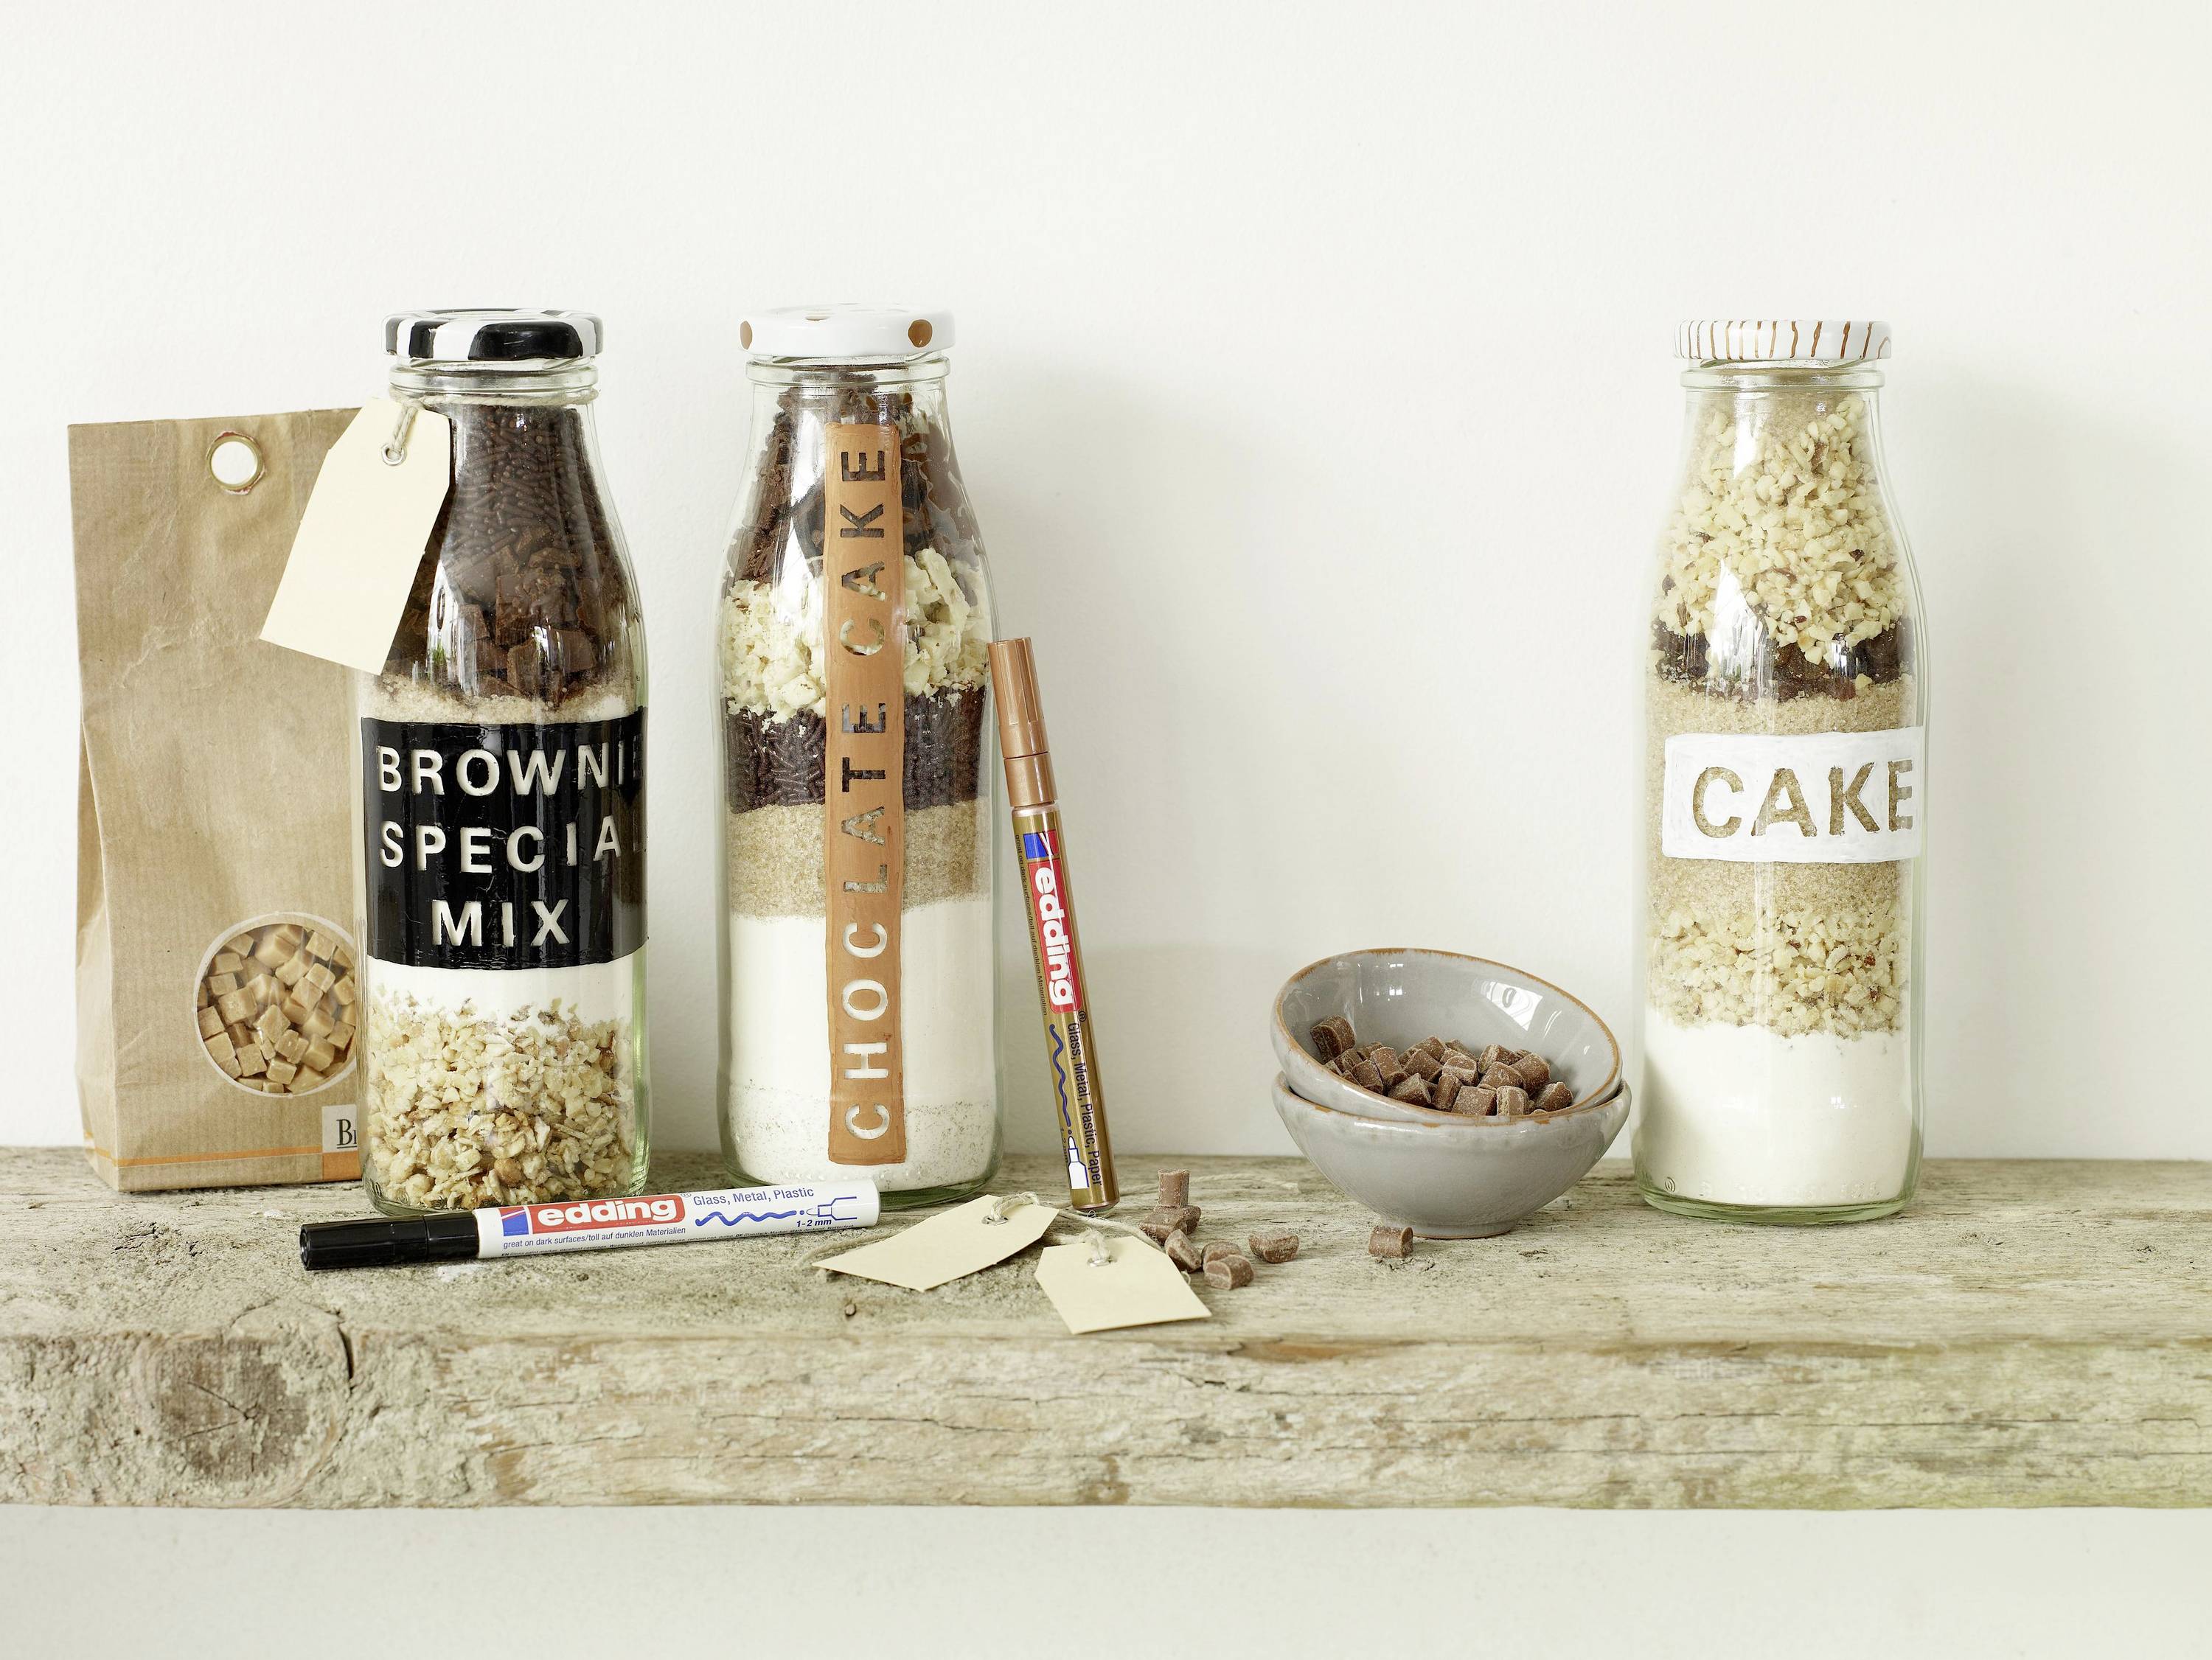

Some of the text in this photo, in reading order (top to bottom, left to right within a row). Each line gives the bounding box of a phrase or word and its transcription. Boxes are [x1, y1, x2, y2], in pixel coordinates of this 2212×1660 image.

[840, 450, 890, 1140] CHOCLATE CAKE
[1692, 759, 1913, 838] CAKE
[379, 815, 644, 873] SPECIA
[431, 899, 571, 947] MIX
[1034, 866, 1074, 1006] edding
[1068, 1022, 1103, 1187] Glass, Metal, Plastic, Paper
[538, 1199, 678, 1227] edding
[693, 1188, 814, 1207] Glass, Metal, Plastic
[797, 1219, 813, 1227] 1-2
[503, 1241, 523, 1249] great
[536, 1237, 552, 1246] dark
[554, 1233, 600, 1244] surfaces/toll
[601, 1232, 613, 1241] auf
[615, 1230, 644, 1239] dunklen
[646, 1227, 686, 1237] Materialien
